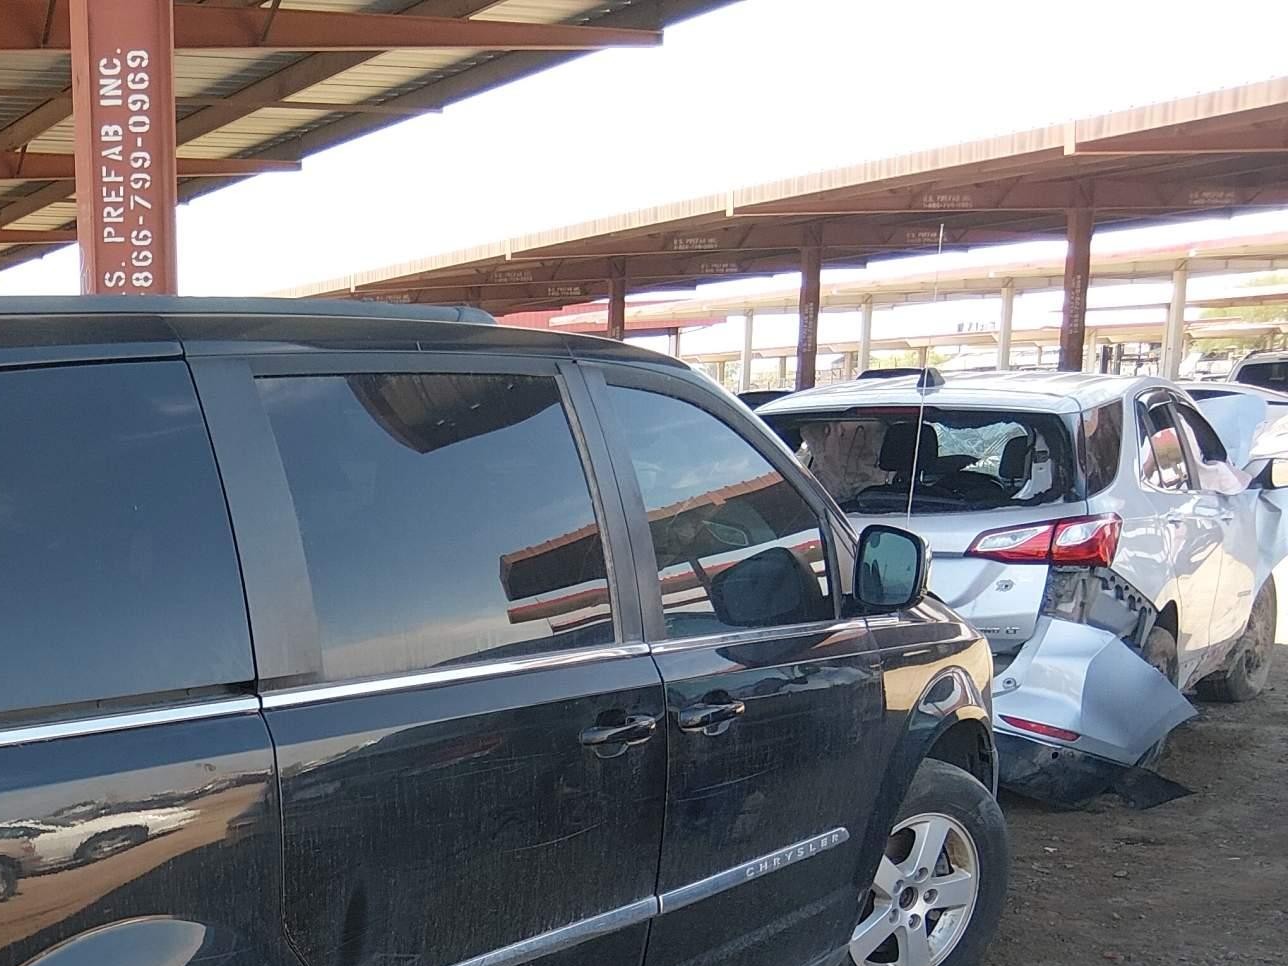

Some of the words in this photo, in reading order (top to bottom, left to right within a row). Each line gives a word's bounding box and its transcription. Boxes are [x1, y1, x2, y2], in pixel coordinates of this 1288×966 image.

[99, 48, 123, 106] INC.
[101, 124, 125, 243] PREFAB
[126, 50, 153, 296] 866-799-0969
[105, 262, 126, 296] .S.
[746, 833, 839, 876] CHRYSLER
